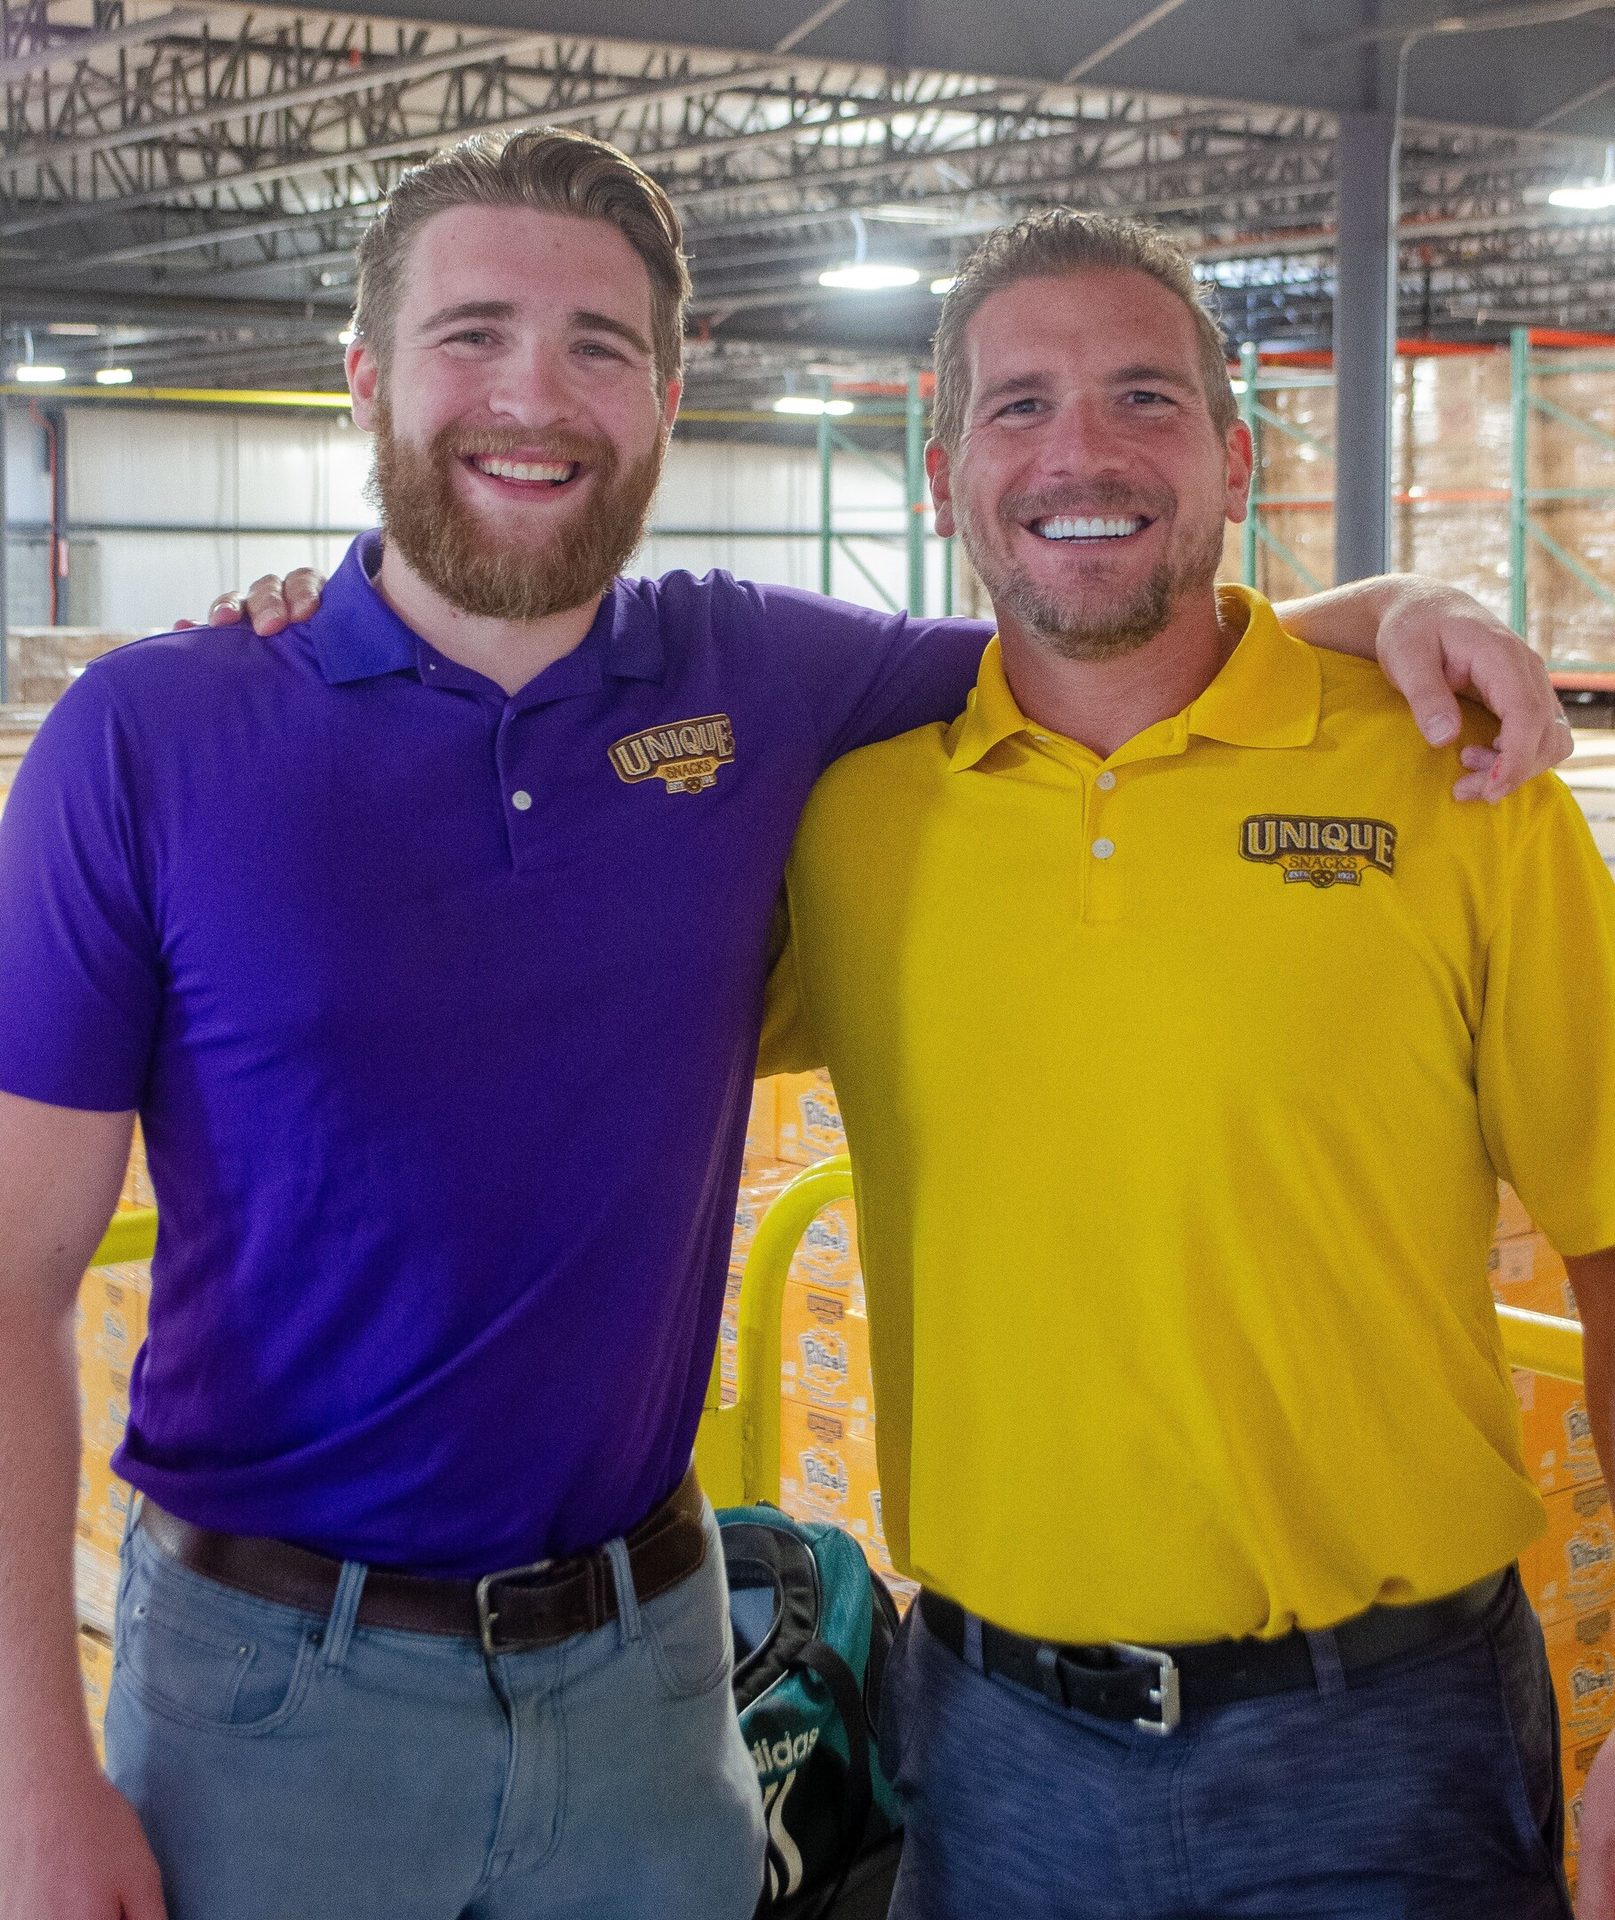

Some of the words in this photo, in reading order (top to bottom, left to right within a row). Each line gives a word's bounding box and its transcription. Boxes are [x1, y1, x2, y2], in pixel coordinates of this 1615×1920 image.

[615, 720, 733, 776] UNIQUE
[667, 760, 712, 779] SNACKS
[1247, 820, 1394, 869] UNIQUE
[1288, 855, 1358, 869] SNACKS
[751, 1727, 819, 1772] didas
